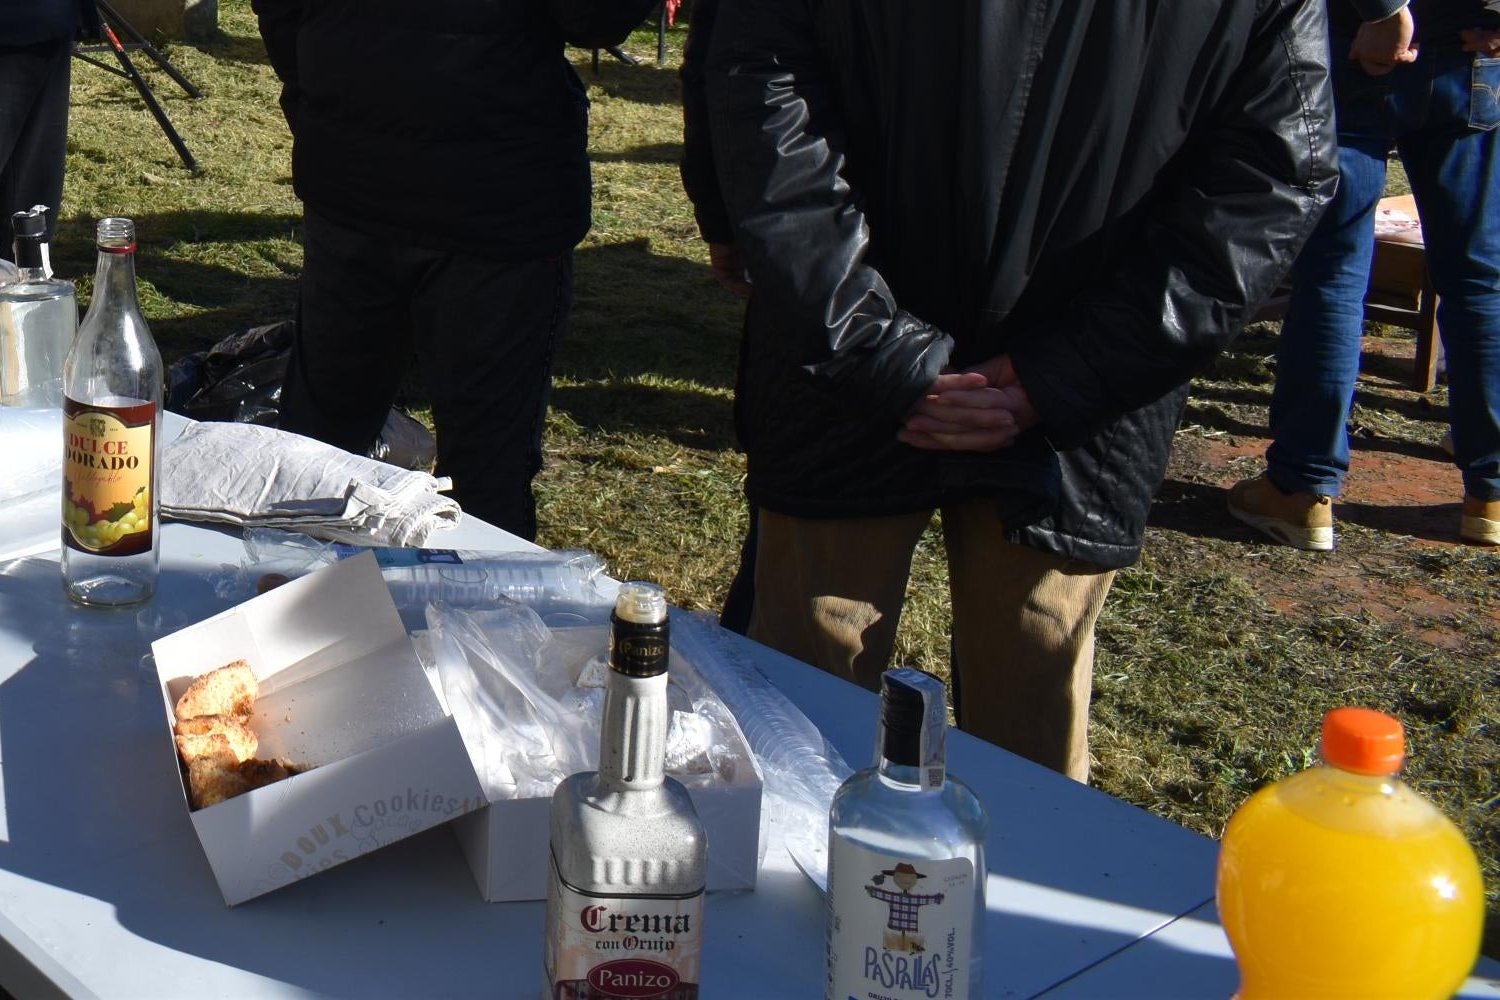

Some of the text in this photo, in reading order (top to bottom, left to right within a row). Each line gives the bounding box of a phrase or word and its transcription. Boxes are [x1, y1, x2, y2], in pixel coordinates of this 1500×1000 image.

[70, 433, 128, 455] DULCE
[65, 444, 139, 470] DORADO
[279, 812, 349, 871] DOUX
[353, 787, 460, 827] Cookies
[580, 905, 690, 934] Crema
[595, 935, 675, 952] con Orujo
[600, 970, 671, 988] Panizo
